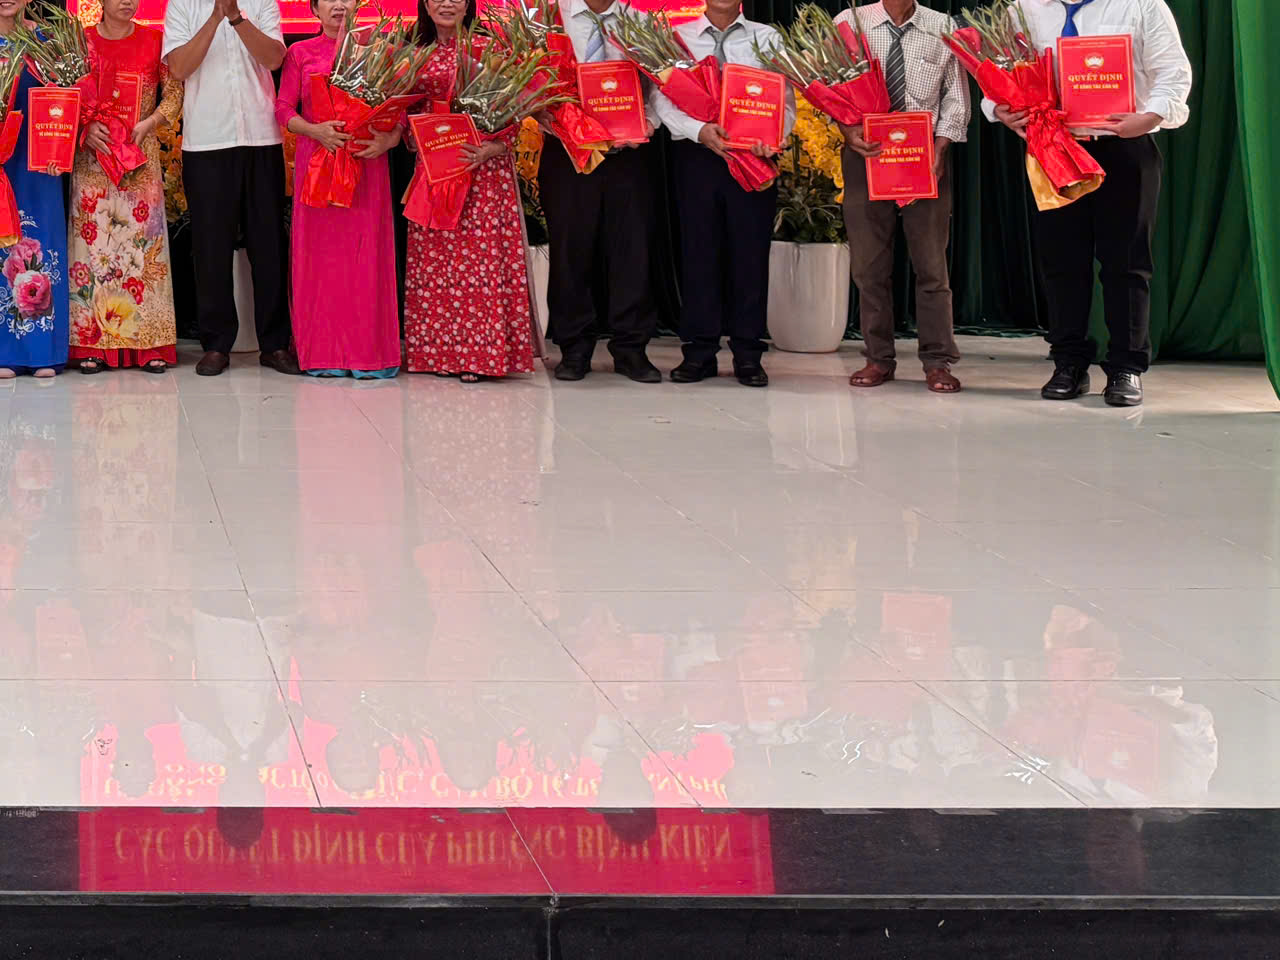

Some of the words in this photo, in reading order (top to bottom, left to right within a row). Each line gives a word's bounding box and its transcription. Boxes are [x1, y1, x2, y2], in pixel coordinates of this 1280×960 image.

[1068, 73, 1097, 82] QUYẾT
[1100, 74, 1123, 82] ĐỊNH
[588, 96, 613, 105] QUYẾT
[615, 96, 634, 104] ĐỊNH
[729, 97, 755, 107] QUYẾT
[35, 121, 58, 130] QUYẾT
[424, 136, 449, 148] QUYẾT
[882, 146, 901, 156] UYẾT
[903, 147, 924, 155] ĐỊNH
